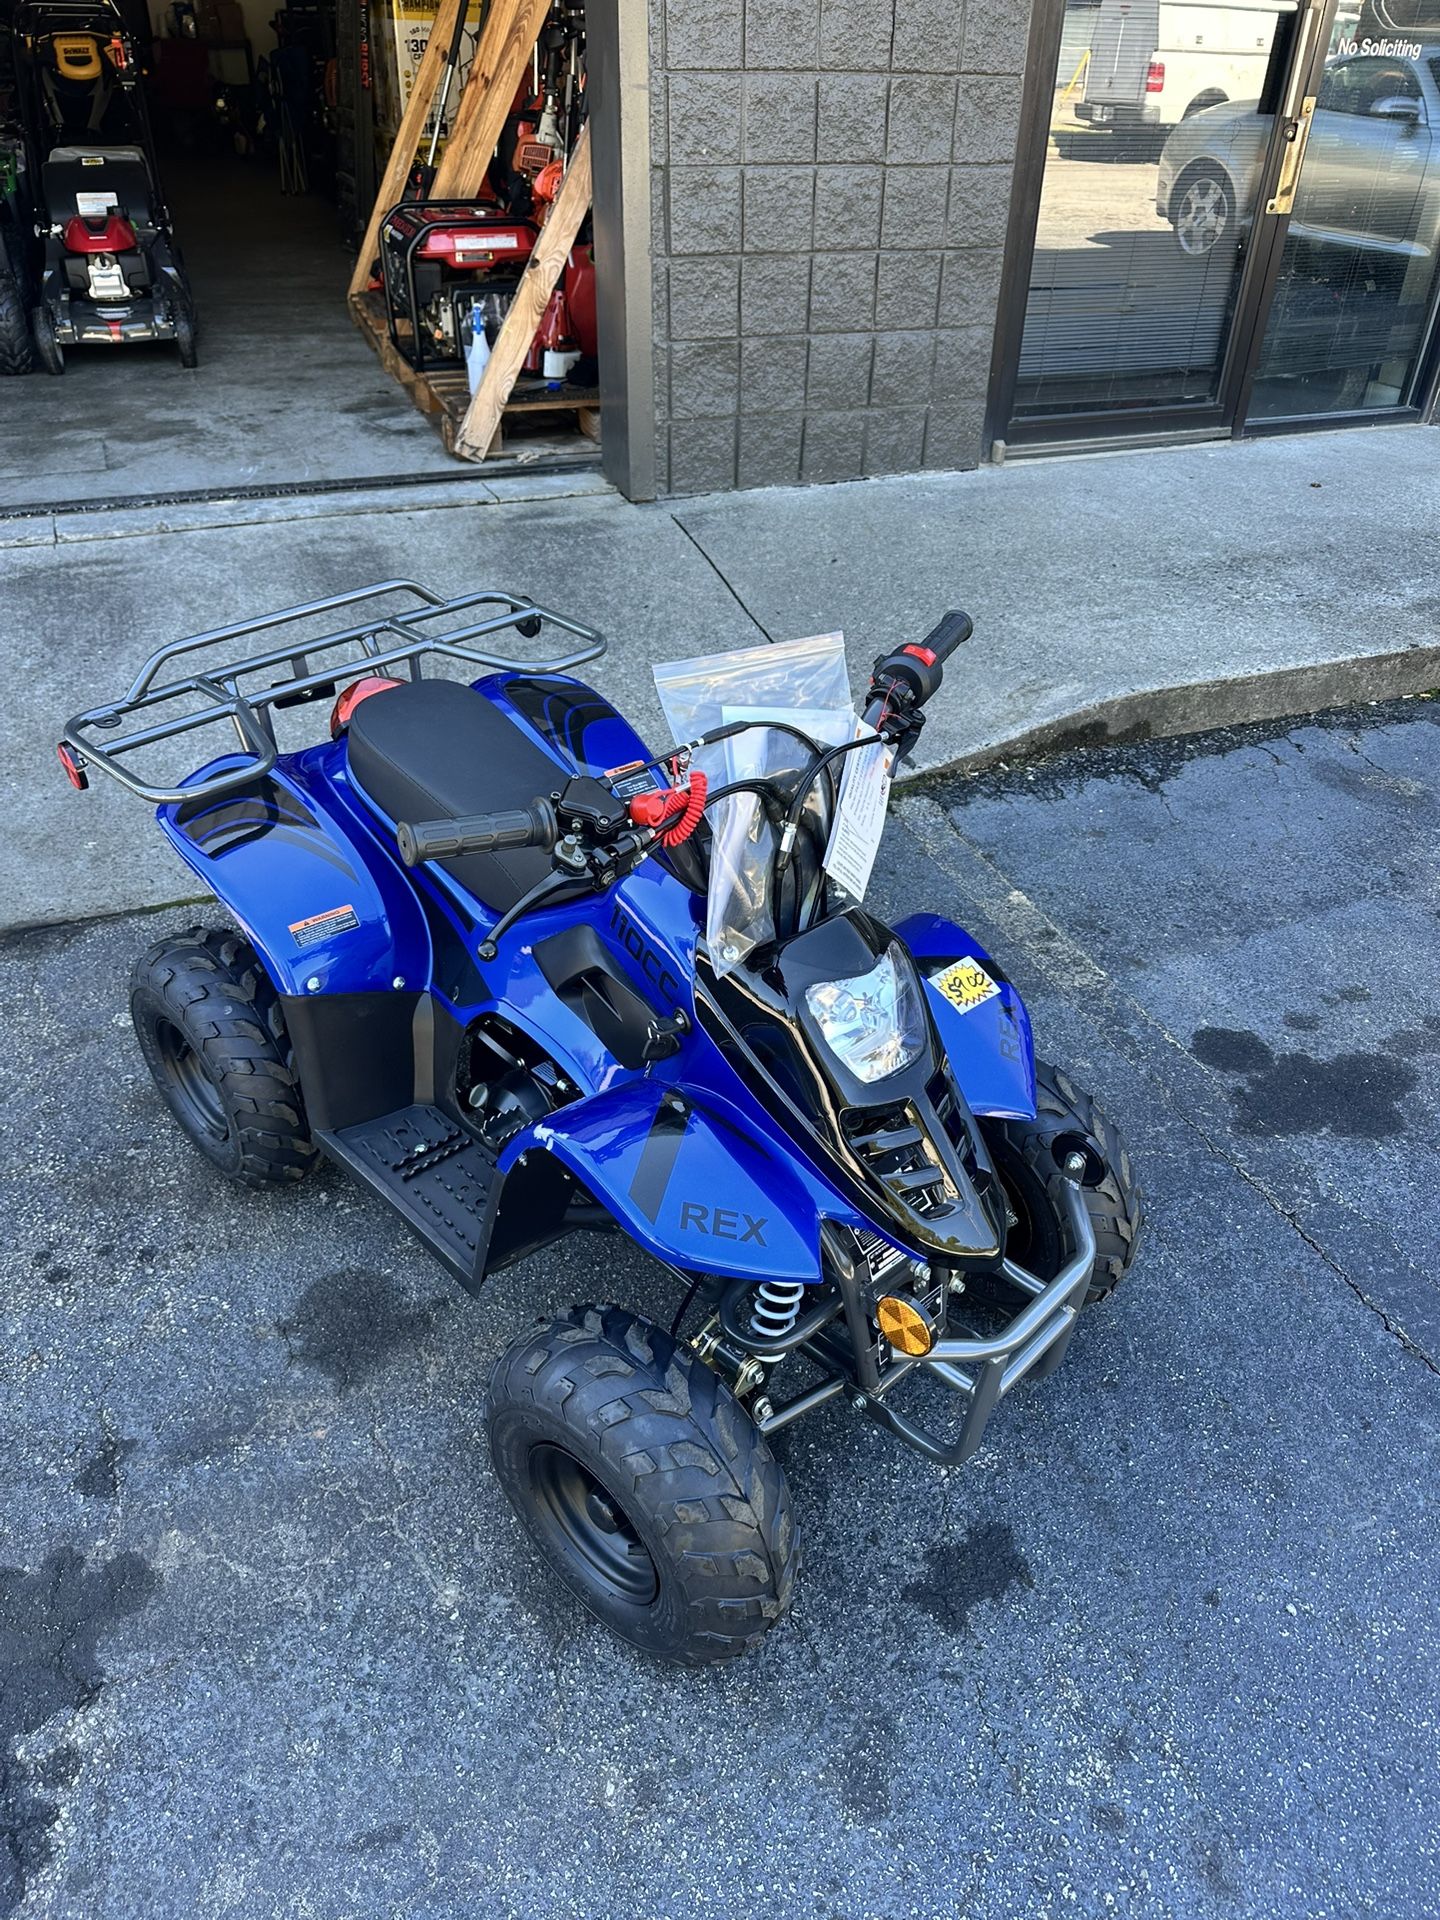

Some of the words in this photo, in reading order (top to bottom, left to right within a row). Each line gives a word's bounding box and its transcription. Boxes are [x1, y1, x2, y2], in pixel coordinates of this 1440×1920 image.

[1338, 38, 1358, 55] No
[1360, 38, 1422, 60] Soliciting
[312, 910, 341, 922] WARNING
[610, 904, 679, 1004] 110CC
[680, 1201, 769, 1248] REX
